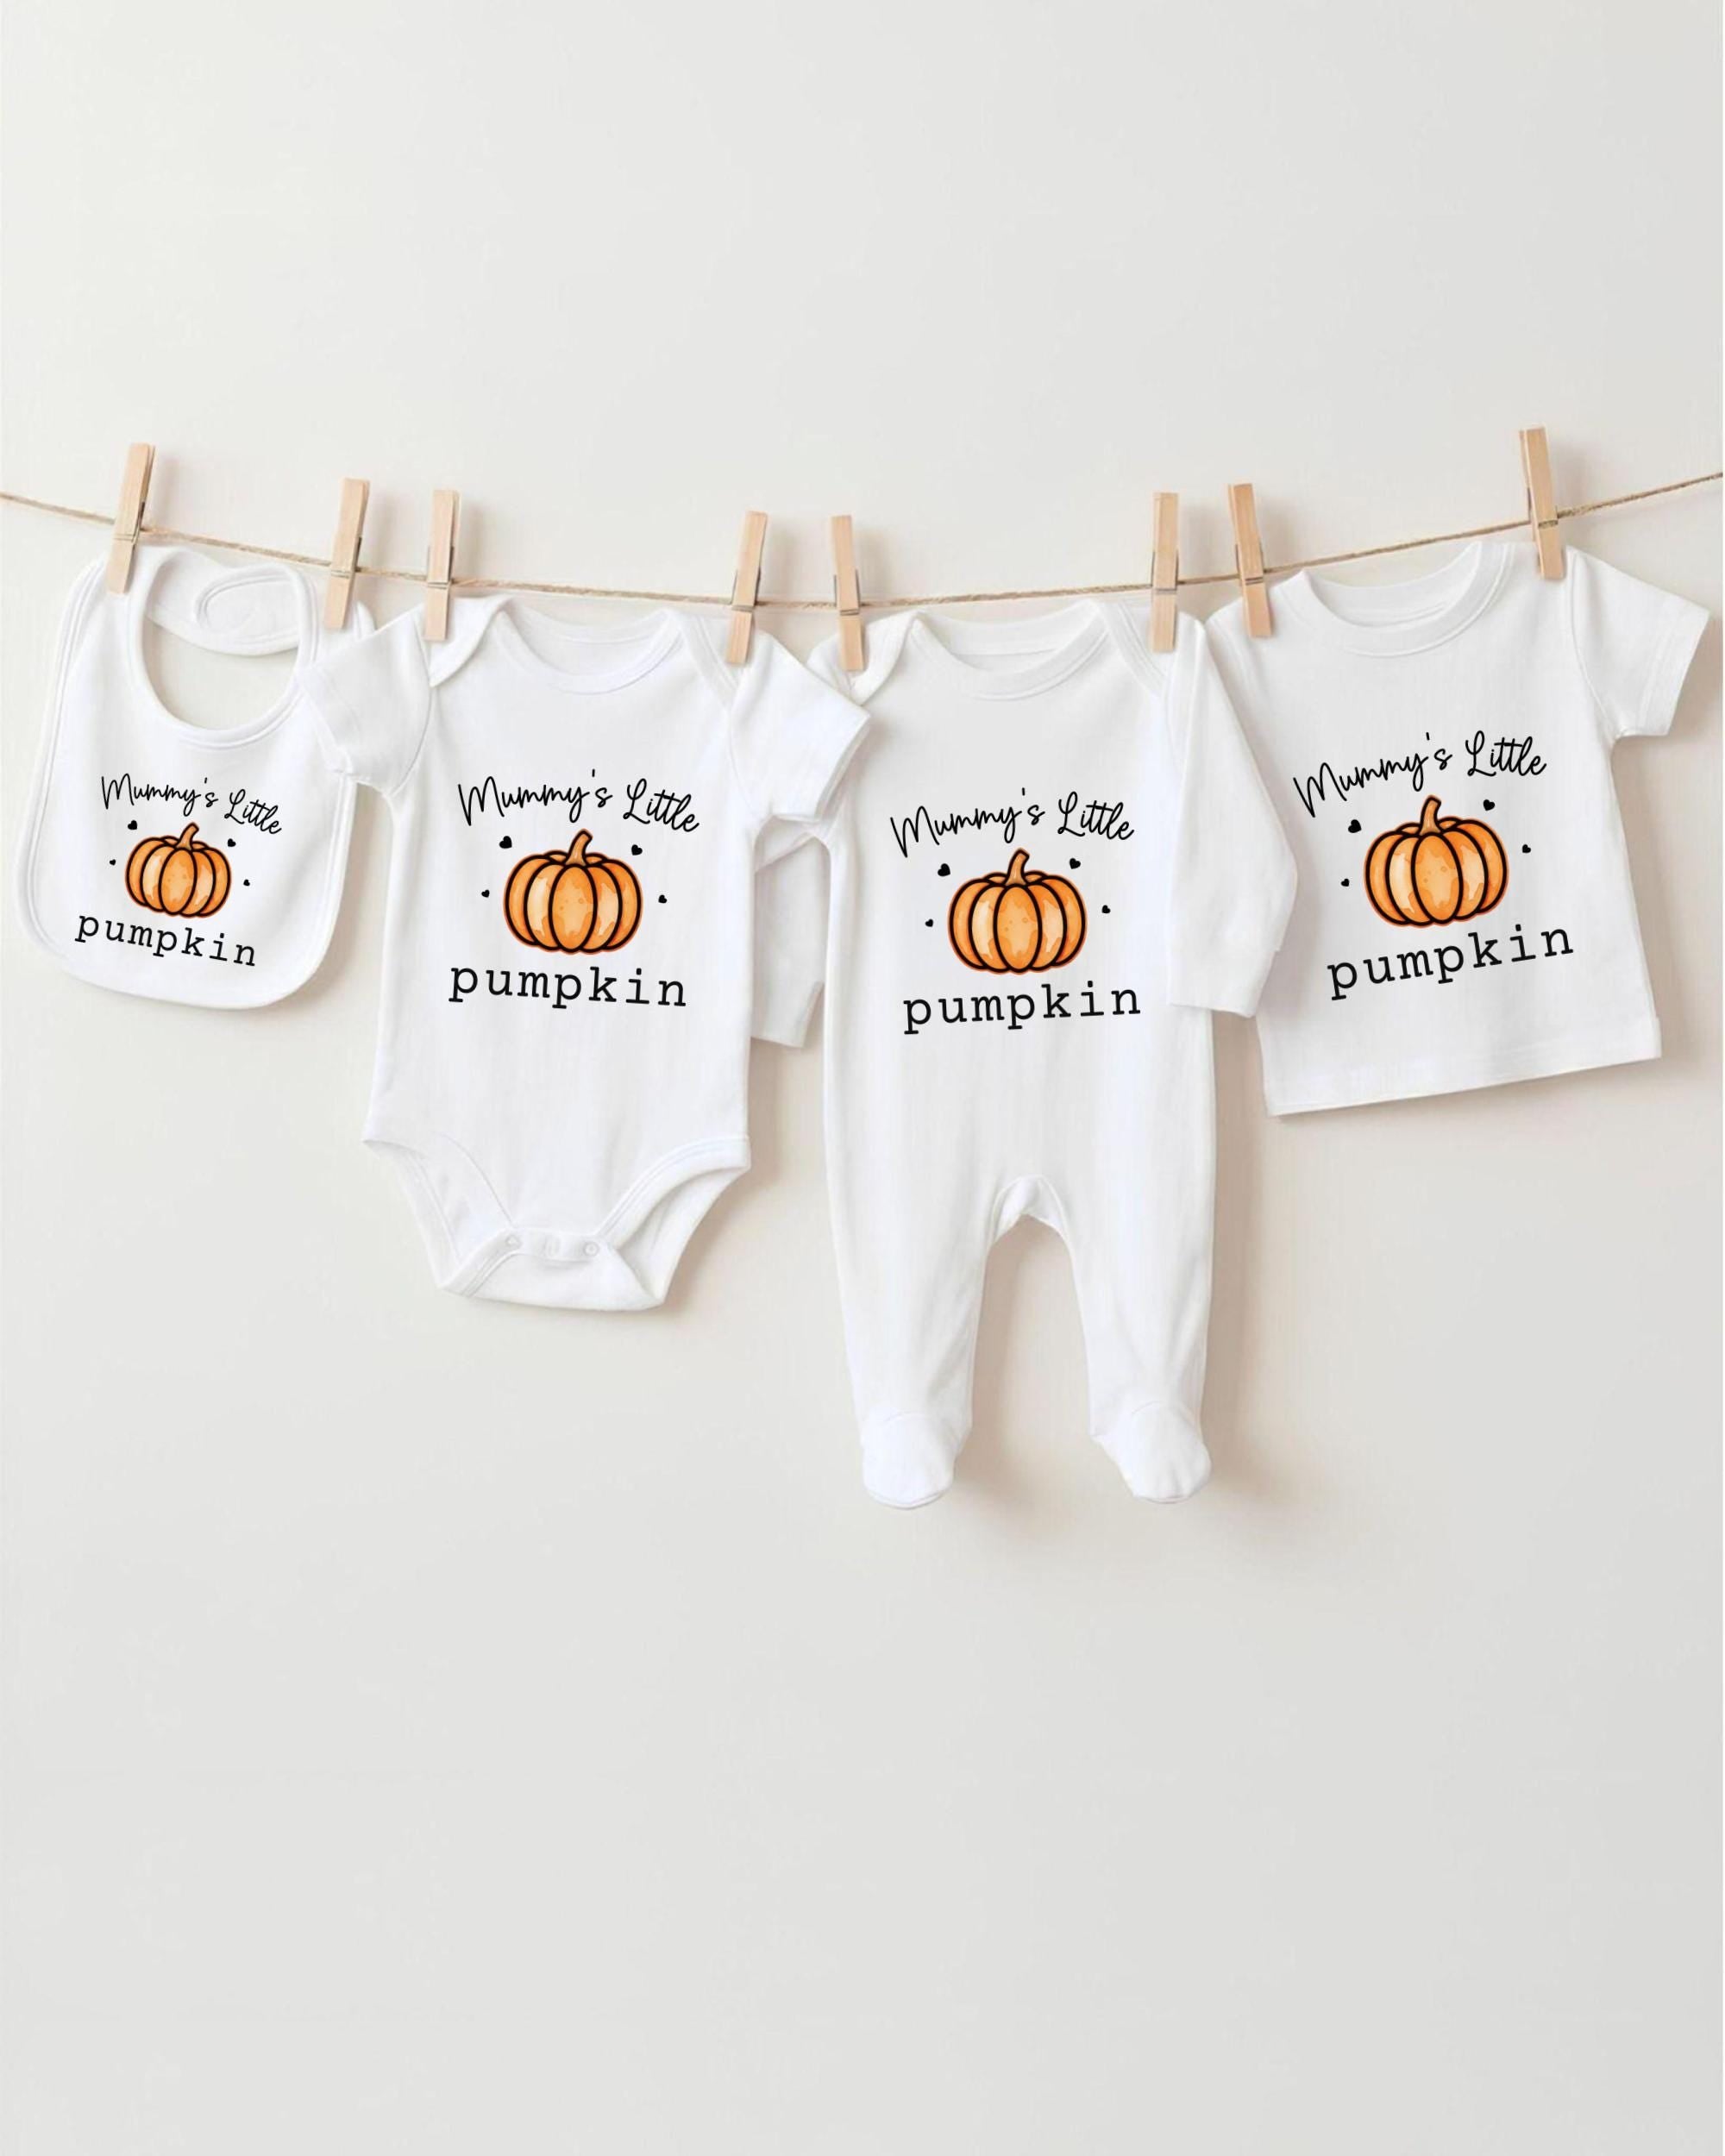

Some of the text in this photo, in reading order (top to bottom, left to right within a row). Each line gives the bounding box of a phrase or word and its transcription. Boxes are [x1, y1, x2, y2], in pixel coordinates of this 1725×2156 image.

[101, 773, 283, 835] Mummy's Little
[457, 768, 700, 833] Mummy's Little
[1292, 730, 1547, 818] Mummy's Little
[889, 787, 1135, 857] Mummy's Little
[74, 915, 255, 967] pumpkin
[1327, 924, 1574, 1001] pumpkin
[448, 966, 687, 1010] pumpkin
[902, 980, 1141, 1035] pumpkin
